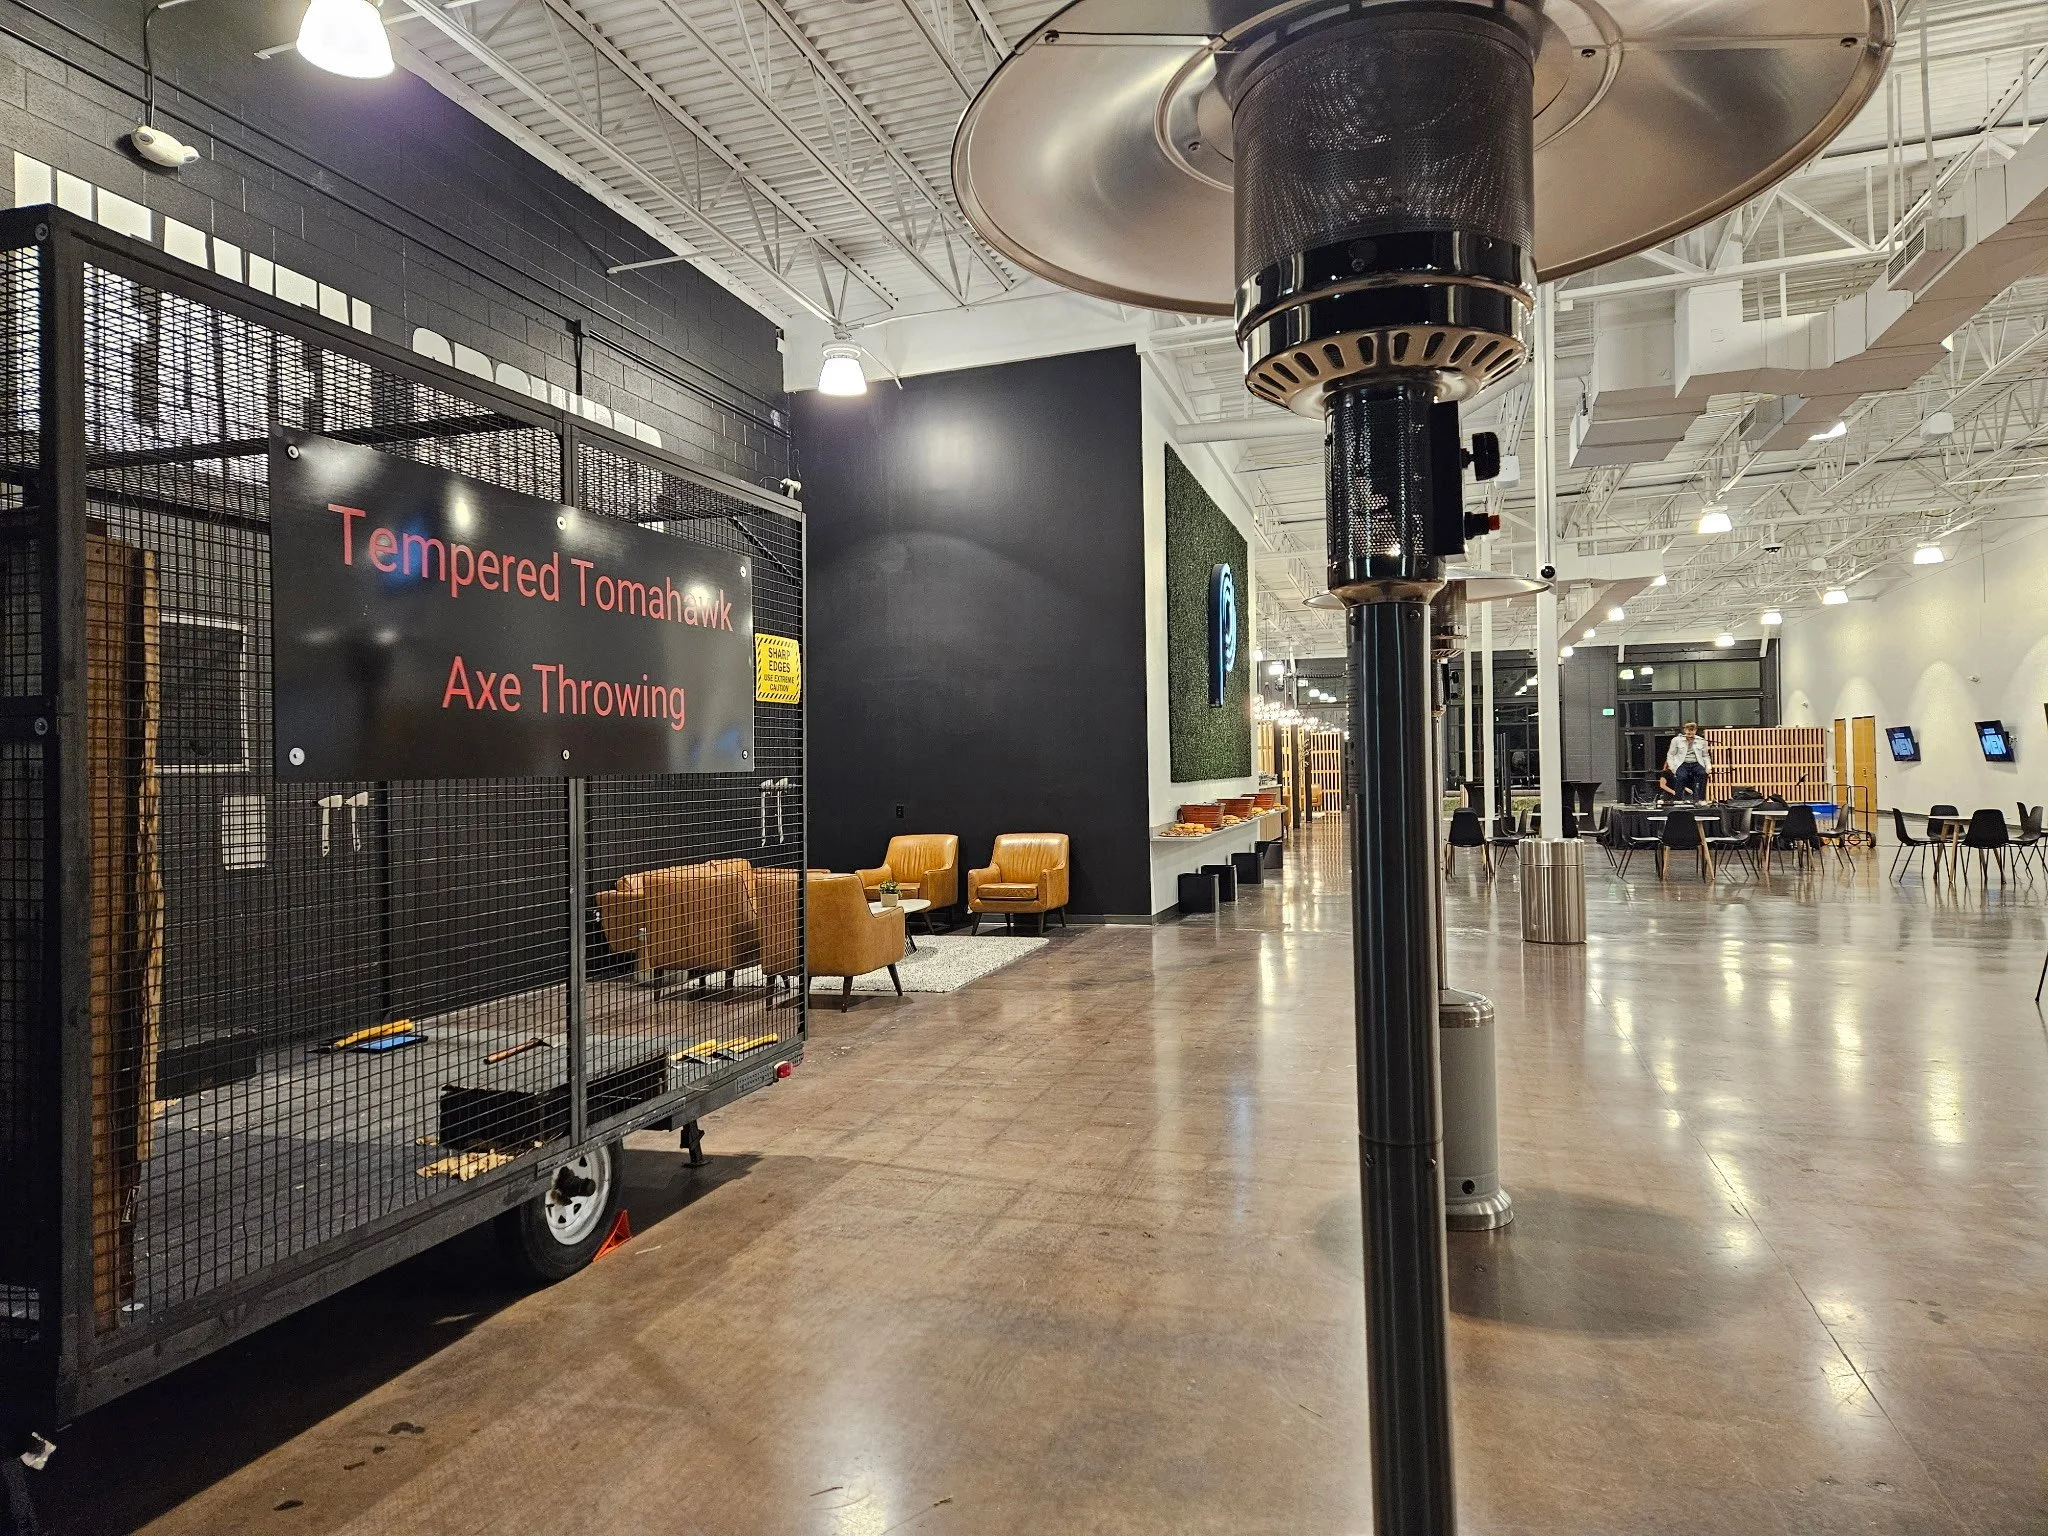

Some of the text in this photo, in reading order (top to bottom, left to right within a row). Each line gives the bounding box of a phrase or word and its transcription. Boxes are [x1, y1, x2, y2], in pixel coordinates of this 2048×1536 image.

[327, 503, 734, 632] Tempered Tomahawk
[768, 647, 790, 660] SHARP
[768, 660, 790, 673] EDGES
[763, 673, 794, 684] USE EXTREME
[441, 655, 686, 731] Axe Throwing
[769, 683, 789, 692] CAUTION
